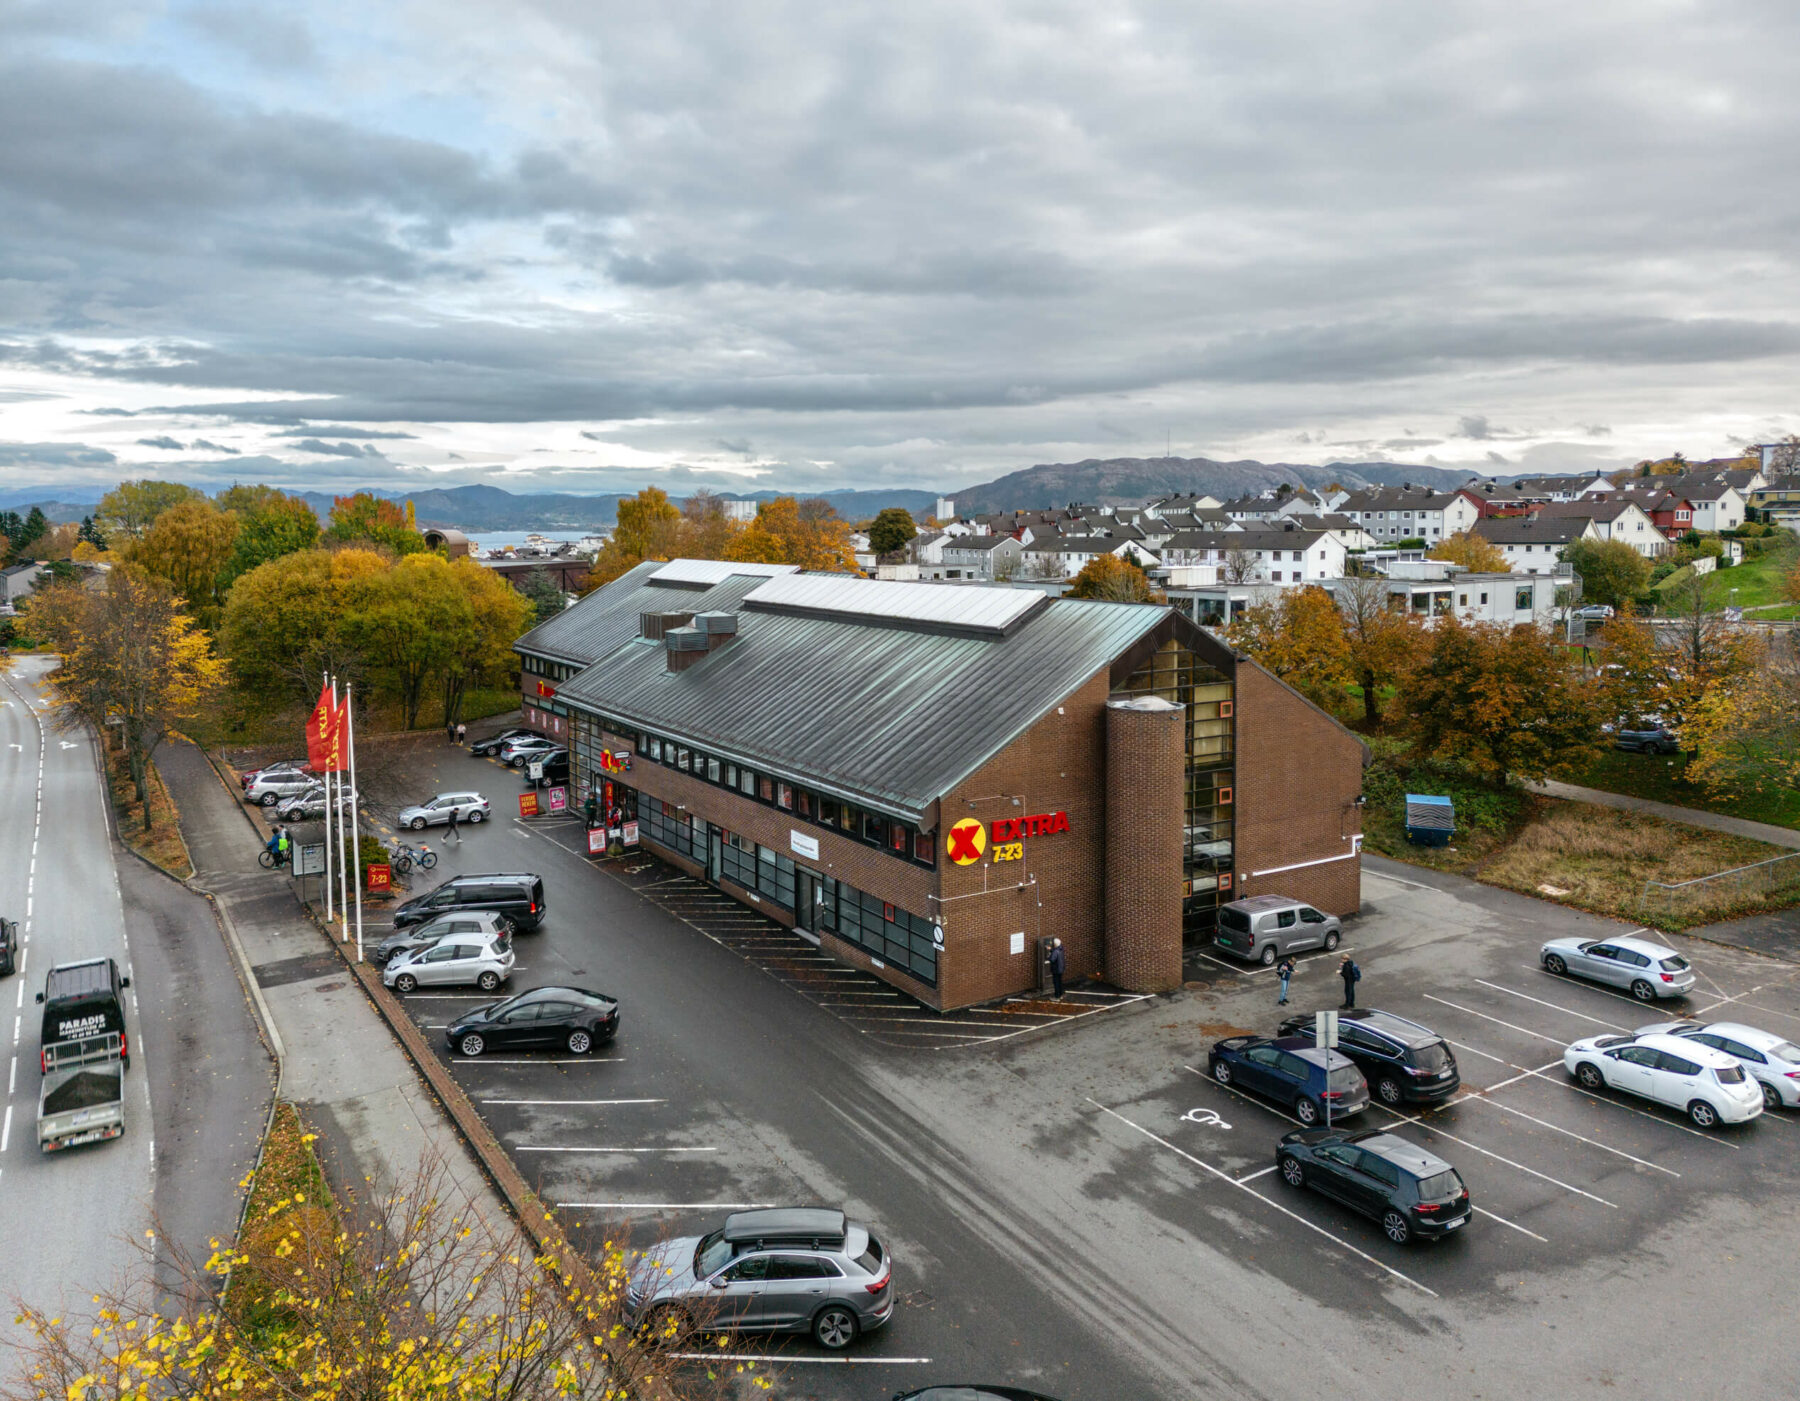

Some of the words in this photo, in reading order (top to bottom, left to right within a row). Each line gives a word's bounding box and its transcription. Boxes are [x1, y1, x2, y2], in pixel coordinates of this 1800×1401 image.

[992, 811, 1070, 843] EXTRA
[992, 842, 1024, 863] 7-23
[371, 874, 388, 884] 7-23
[59, 1014, 106, 1031] PARADIS
